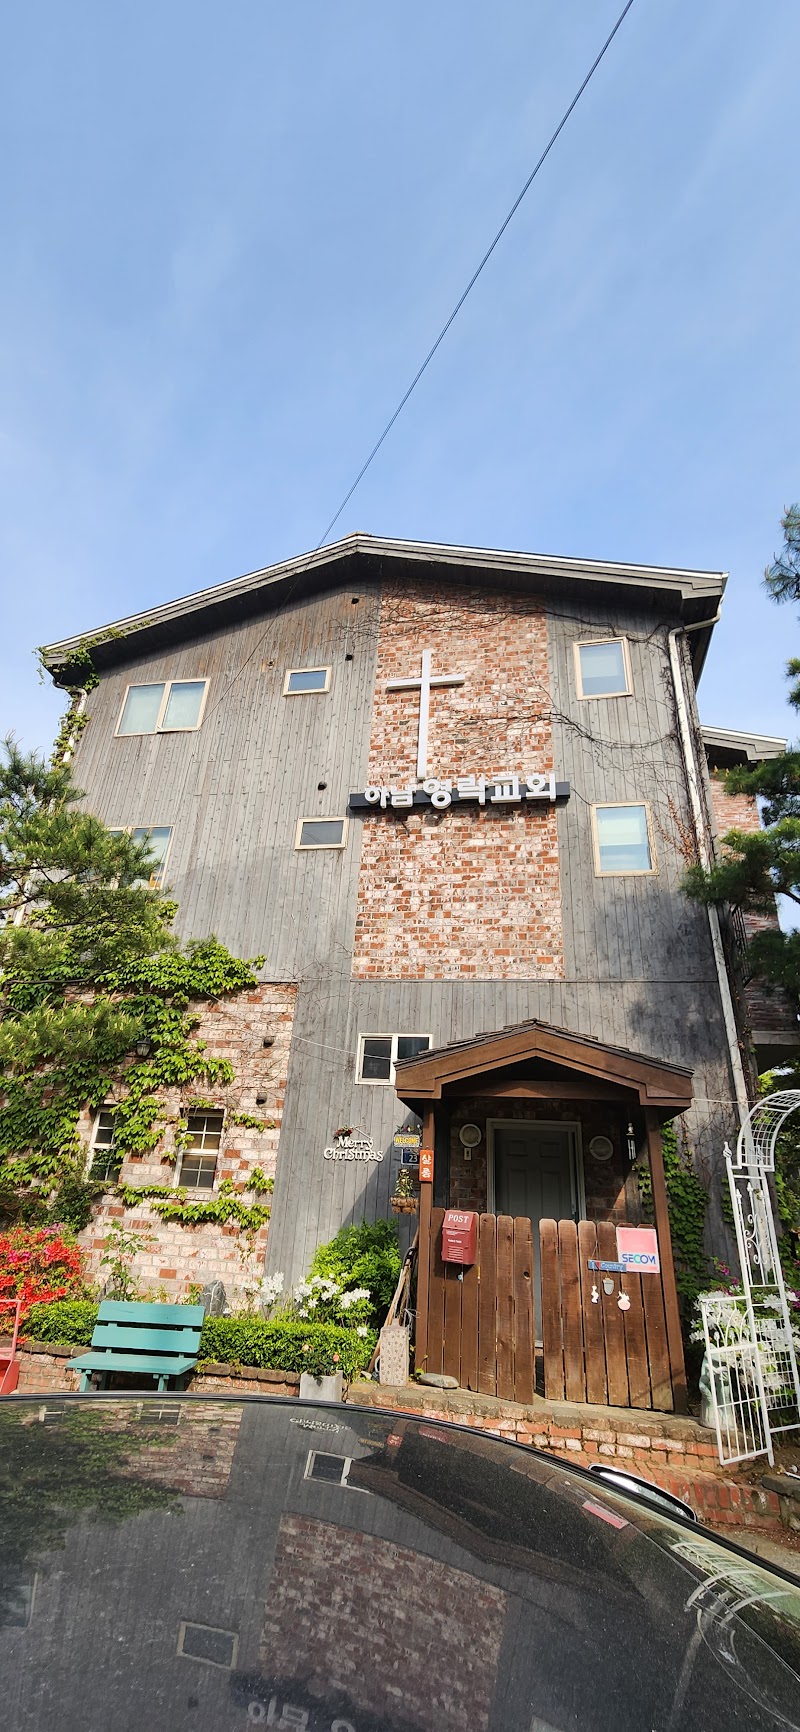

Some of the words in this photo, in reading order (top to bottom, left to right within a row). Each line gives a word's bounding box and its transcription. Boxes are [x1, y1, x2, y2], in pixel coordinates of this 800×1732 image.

[365, 784, 416, 809] 하남
[422, 773, 556, 809] 영락교회
[336, 1136, 373, 1149] Merry
[395, 1136, 418, 1145] WELCOME
[324, 1147, 384, 1163] Christmas
[408, 1154, 418, 1162] 23
[448, 1214, 469, 1224] POST
[622, 1253, 656, 1264] SECOM
